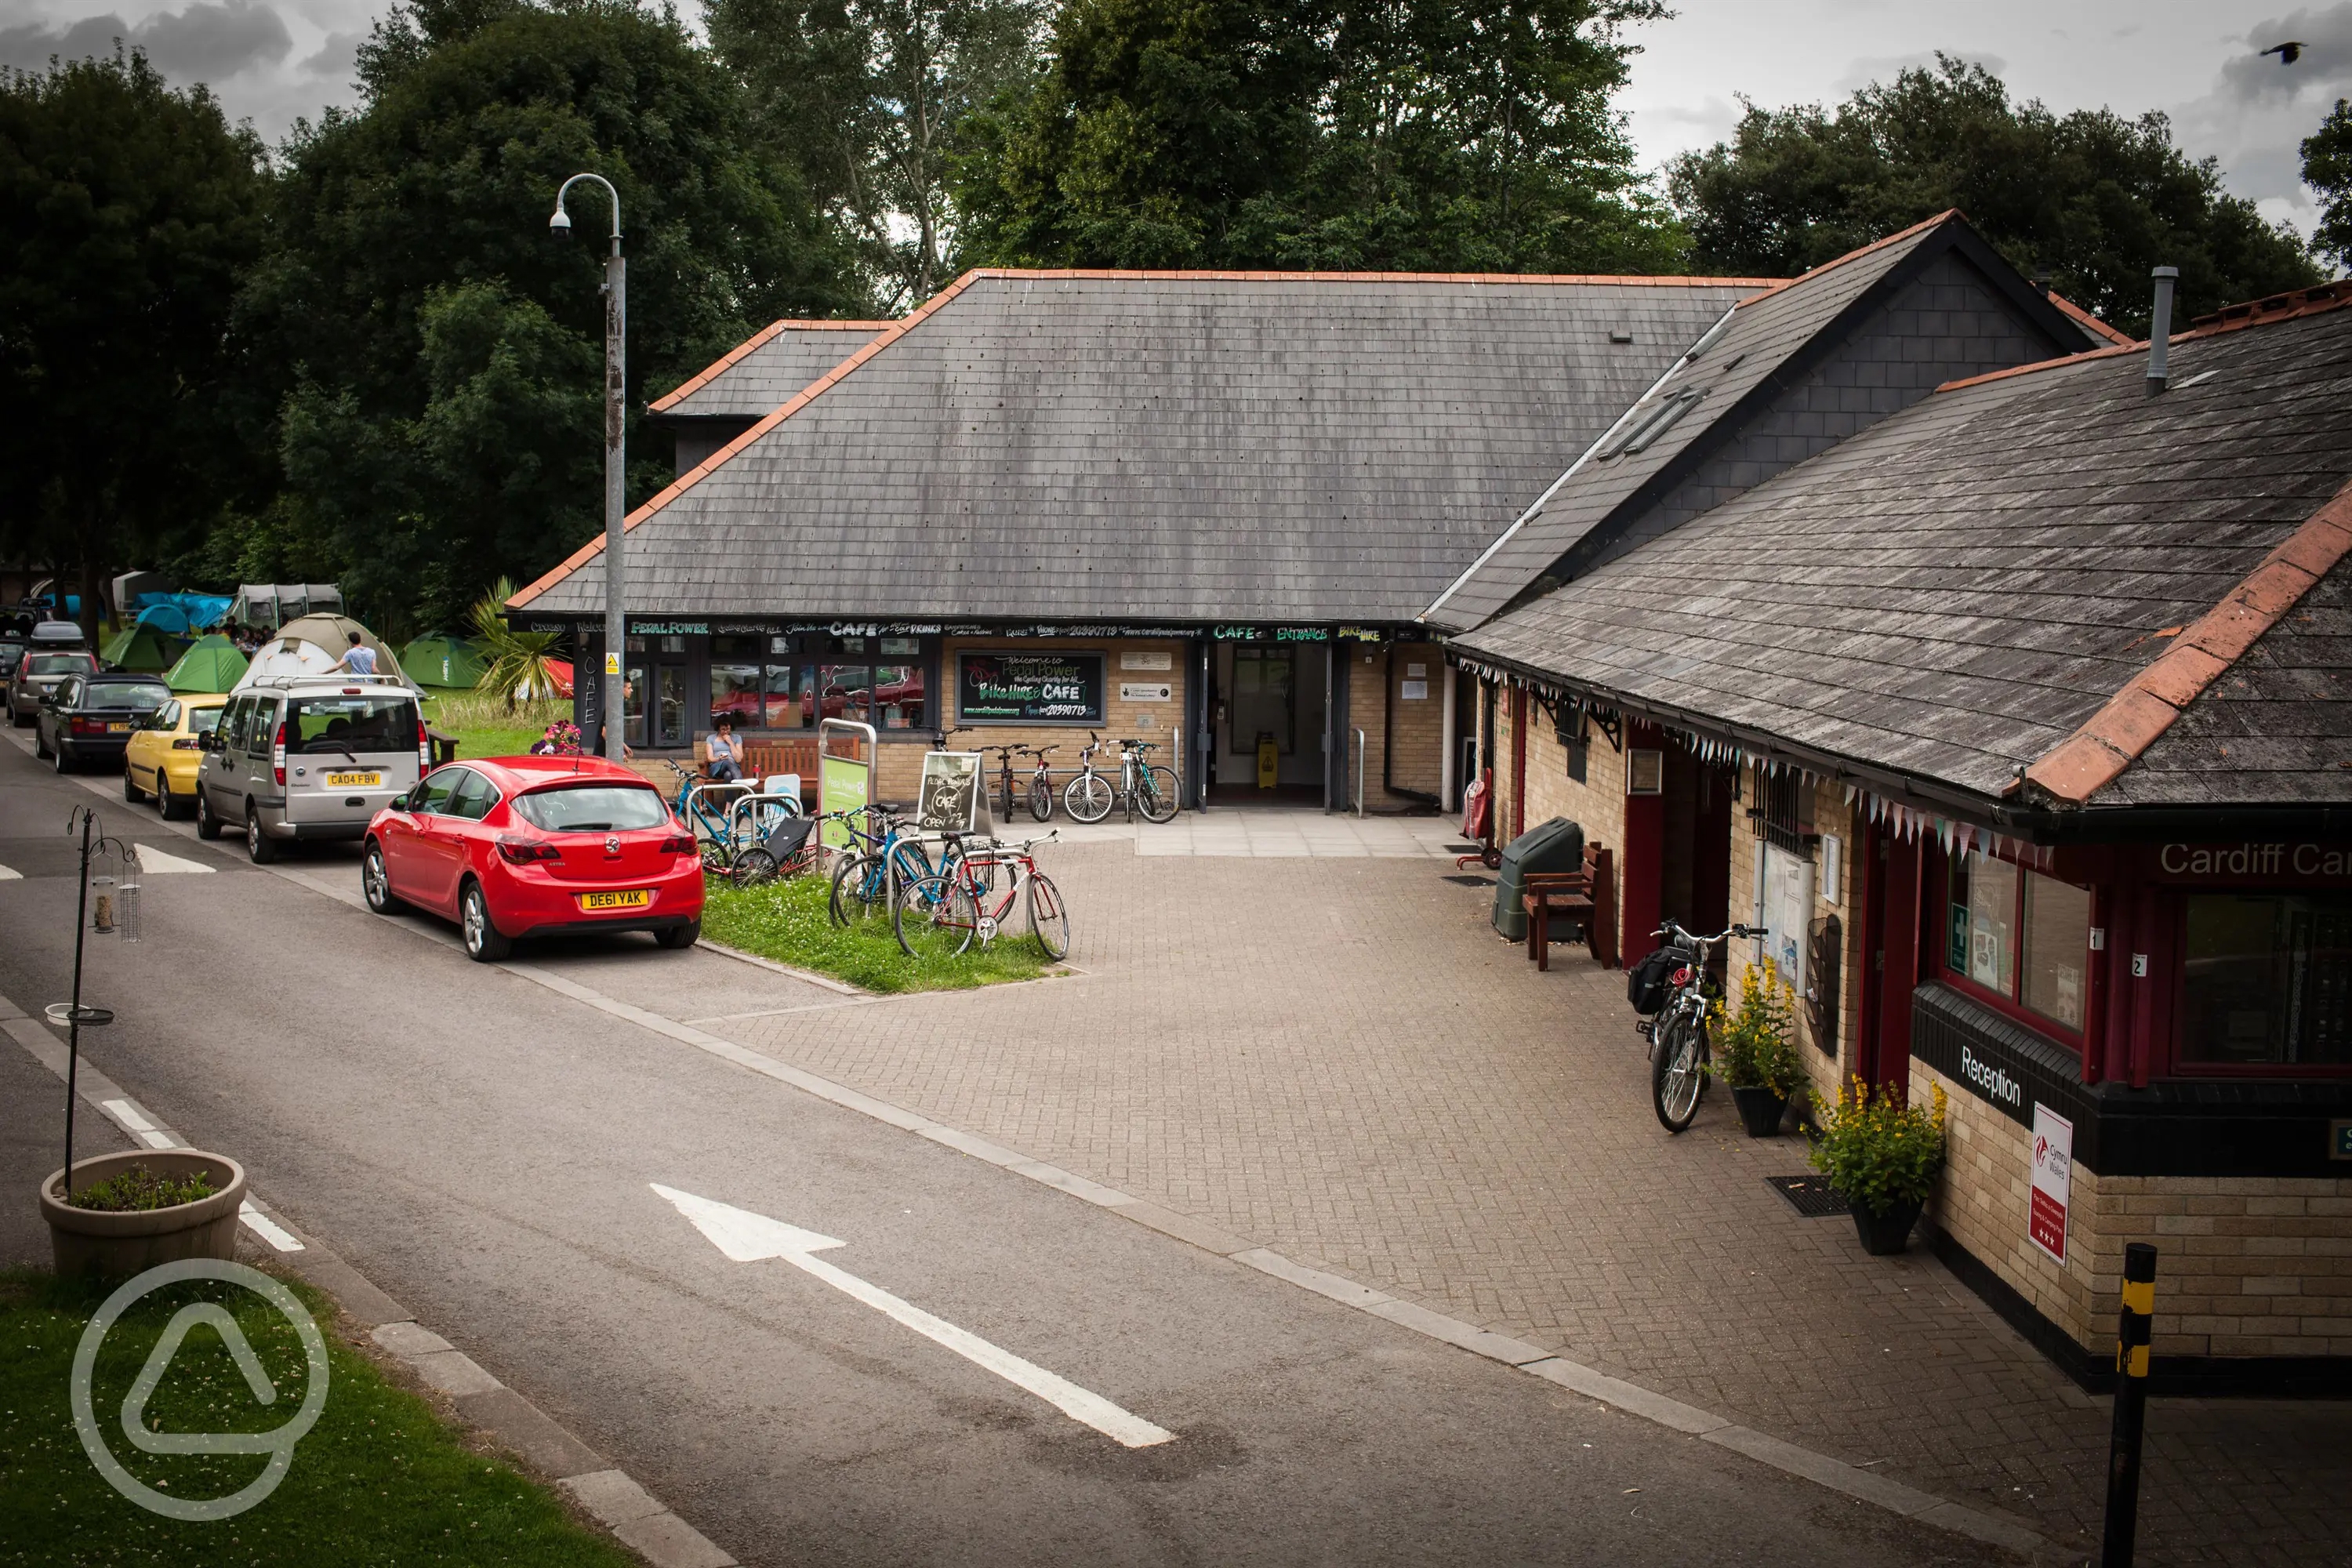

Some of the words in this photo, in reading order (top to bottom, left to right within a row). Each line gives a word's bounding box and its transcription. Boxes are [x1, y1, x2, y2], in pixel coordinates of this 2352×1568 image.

[631, 622, 667, 634] PEDAL
[829, 621, 877, 637] CAFE
[910, 624, 941, 634] DRINKS
[1214, 625, 1254, 639] CAFE
[1277, 627, 1327, 640] ENTRANCE
[1338, 626, 1362, 637] BIKE
[996, 656, 1051, 665] Welcome
[1003, 662, 1034, 676] Pedal
[1038, 662, 1080, 676] Power
[1043, 683, 1080, 699] CAFE
[1047, 704, 1086, 716] 20390713
[331, 775, 355, 784] CA04
[924, 817, 946, 828] OPEN
[2161, 844, 2285, 874] Cardiff
[590, 894, 616, 907] DE61
[618, 892, 641, 905] YAK
[2134, 960, 2141, 975] 2
[1962, 1045, 2020, 1107] Reception
[2050, 1145, 2067, 1165] Cymru
[2049, 1162, 2065, 1180] Wales
